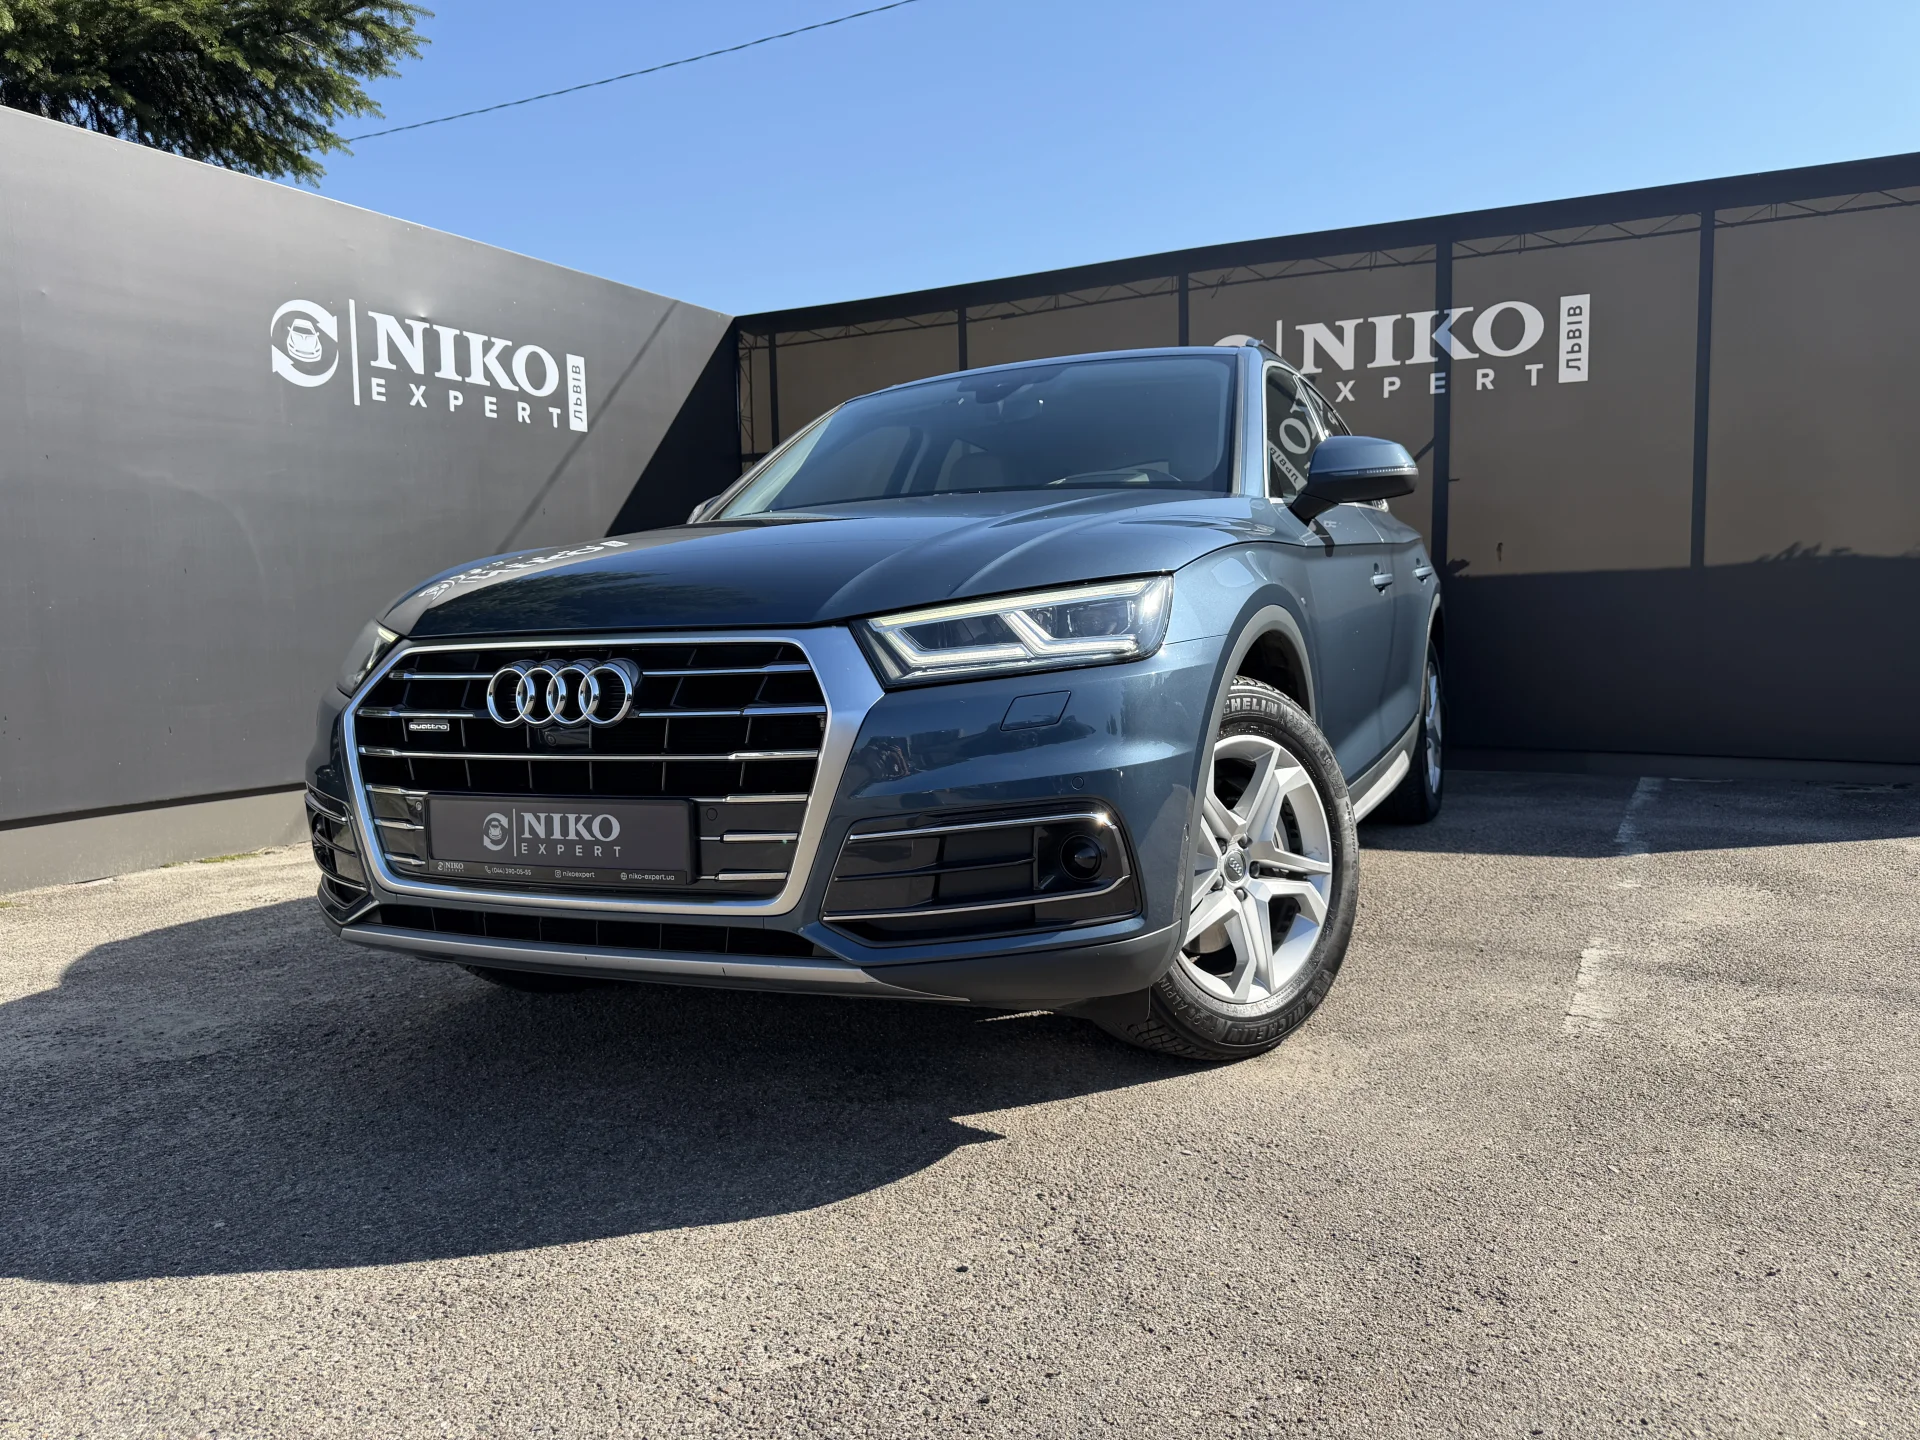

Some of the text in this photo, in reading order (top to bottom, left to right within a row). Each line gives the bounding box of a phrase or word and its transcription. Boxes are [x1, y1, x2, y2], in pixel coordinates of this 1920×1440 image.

[367, 311, 560, 397] NIKO
[1295, 301, 1545, 374] NIKO
[1565, 303, 1583, 372] ЛЬВІВ
[371, 377, 562, 428] EXPERT
[1335, 363, 1544, 403] XPERT
[520, 812, 621, 842] NIKO
[521, 843, 621, 858] EXPERT
